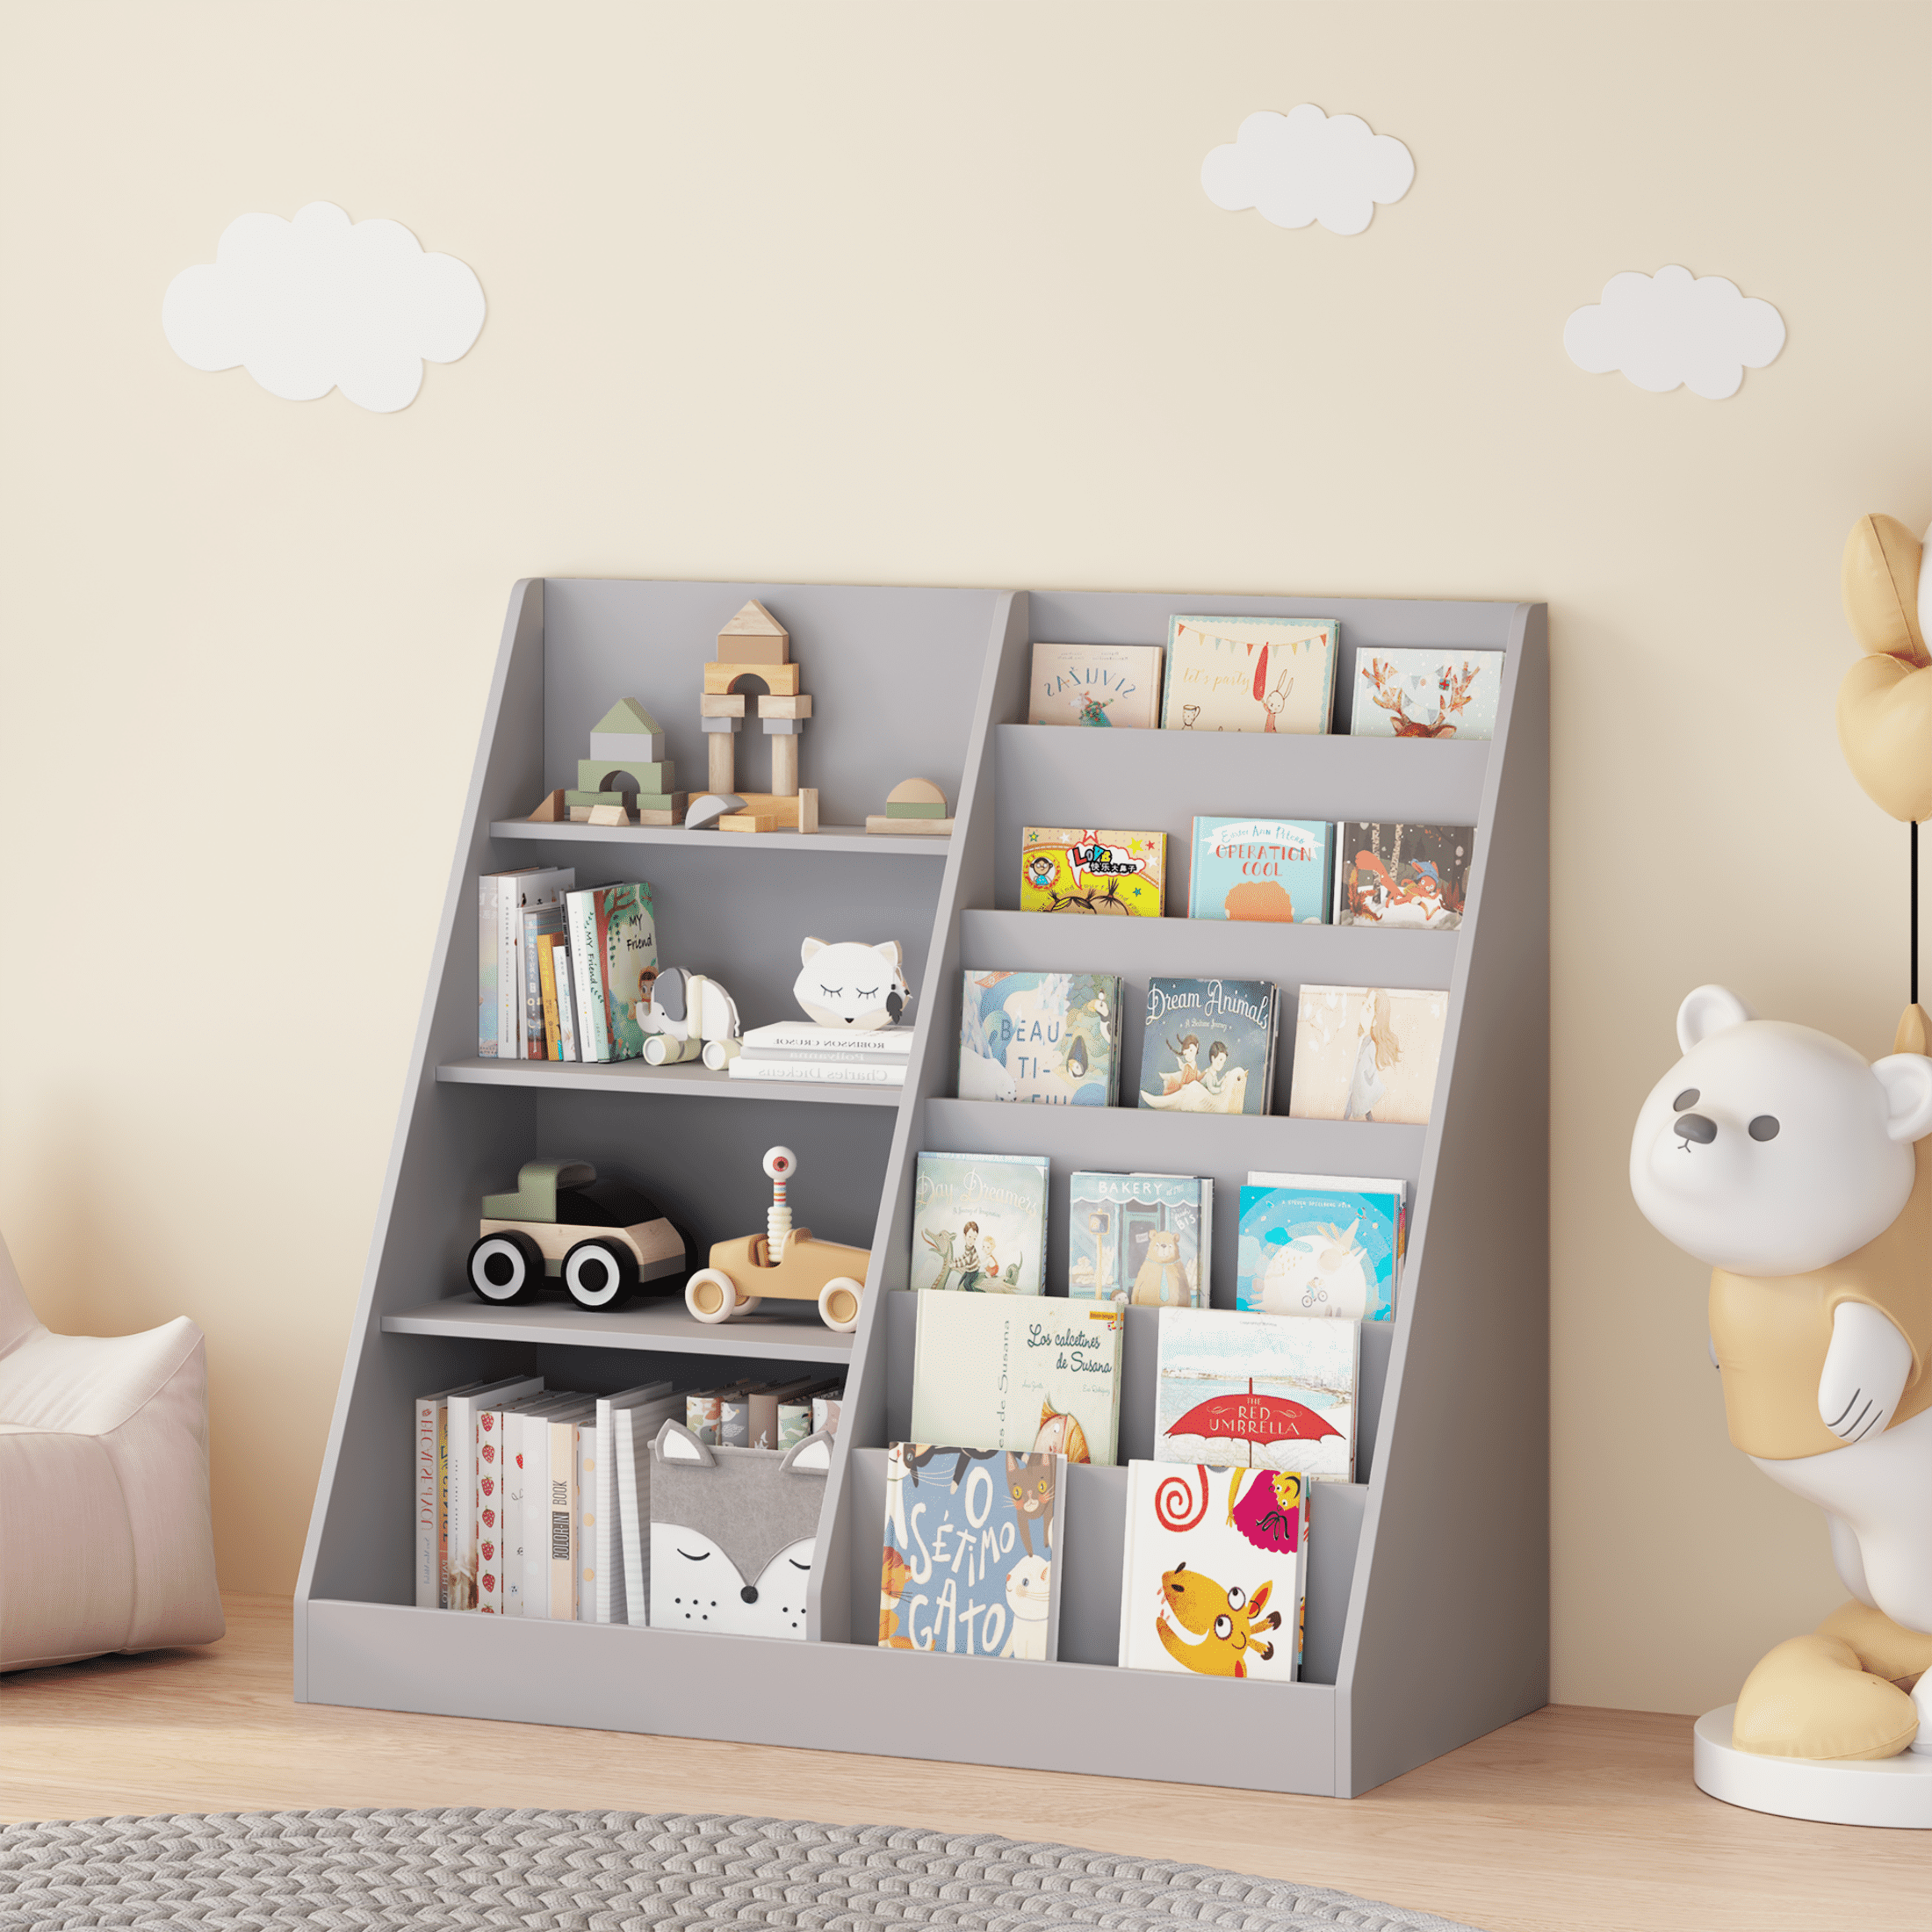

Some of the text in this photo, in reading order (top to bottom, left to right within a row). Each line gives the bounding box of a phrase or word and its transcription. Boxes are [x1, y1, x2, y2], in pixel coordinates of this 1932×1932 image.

[1183, 667, 1251, 695] let's party
[1216, 844, 1311, 861] OPERATION
[1090, 862, 1137, 874] 快乐大鼻子
[1243, 861, 1283, 876] COOL
[630, 913, 643, 931] MY
[627, 933, 652, 952] Friend
[586, 940, 598, 994] MY Friend
[1146, 979, 1269, 1029] Dream Animals
[1018, 1056, 1051, 1078] TI-
[916, 1166, 1037, 1217] Day Dreamers
[1099, 1180, 1163, 1195] BAKERY
[1027, 1323, 1100, 1349] Los calcetines
[998, 1320, 1010, 1395] Susana
[1056, 1351, 1112, 1373] de Susana
[997, 1400, 1006, 1422] de
[1238, 1406, 1271, 1420] RED
[1209, 1417, 1300, 1435] UMBRELLA
[552, 1480, 567, 1505] BOOK
[964, 1466, 993, 1529] O
[910, 1502, 1016, 1588] SÉTIMO
[908, 1577, 1006, 1654] GATO
